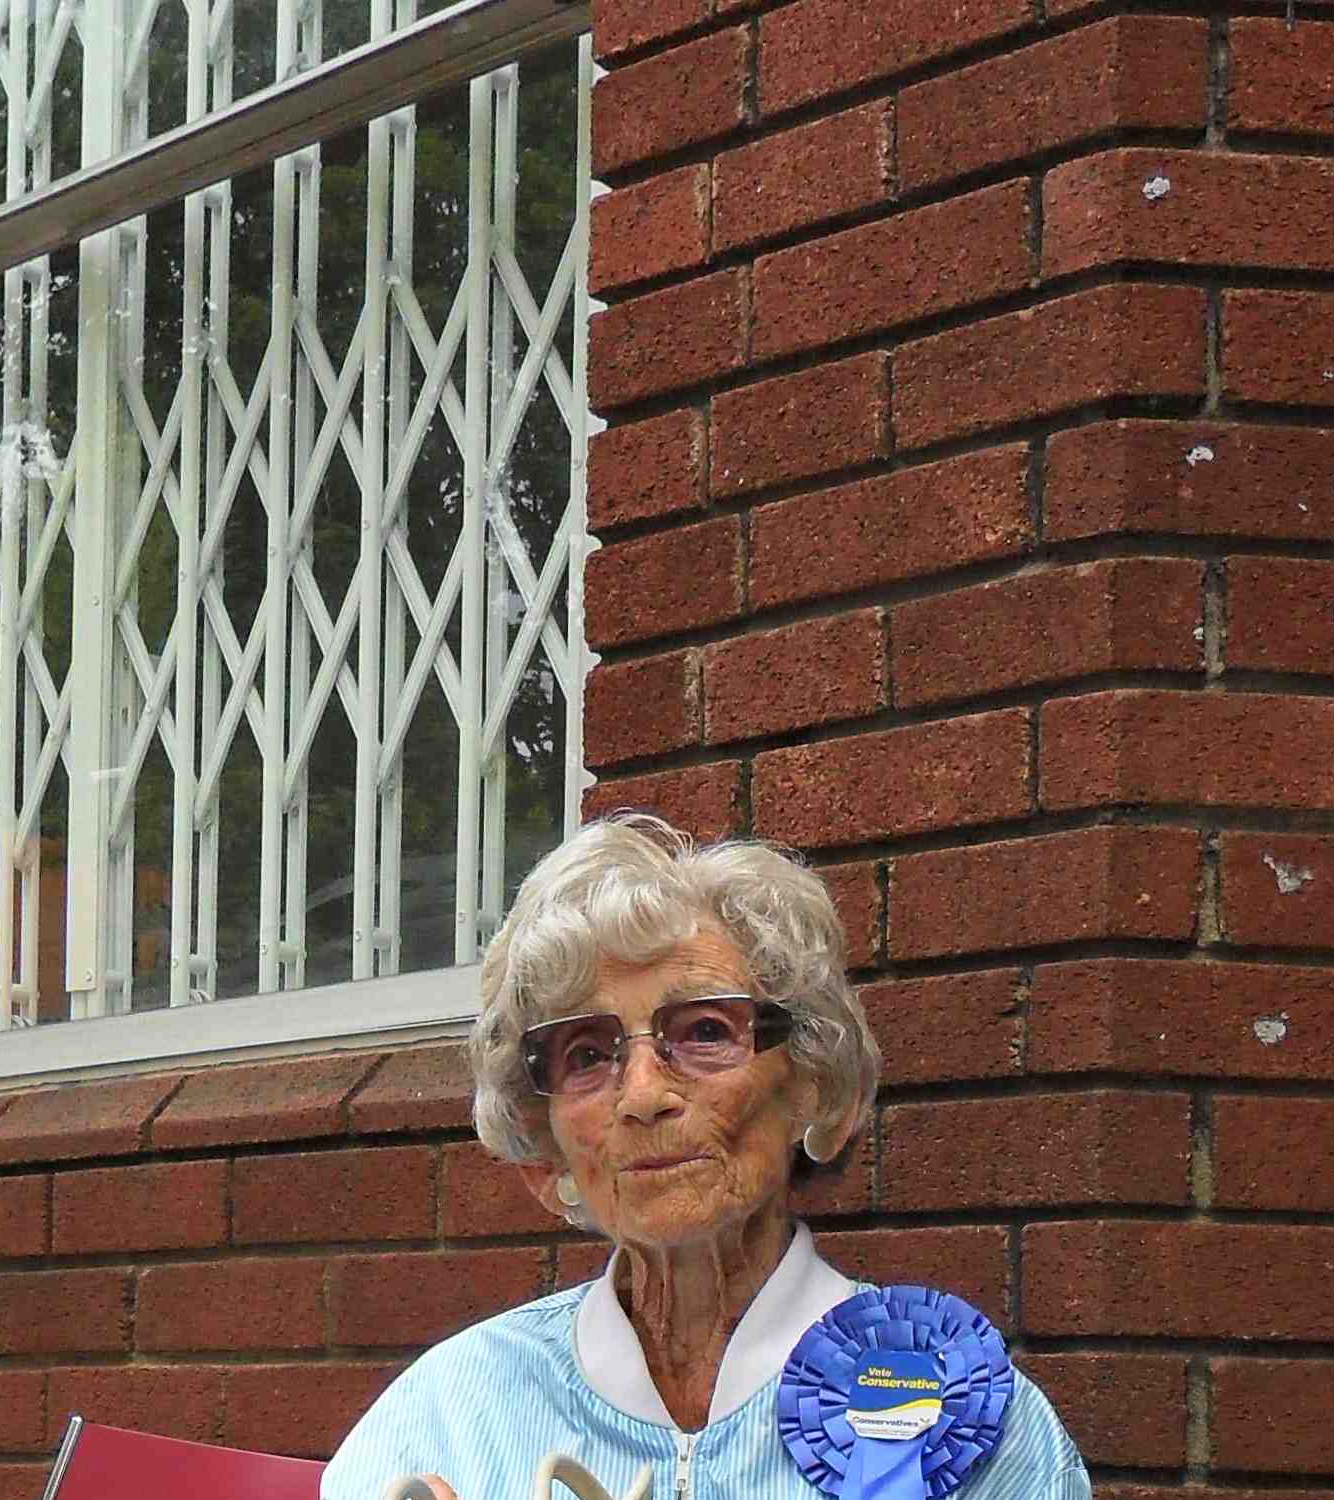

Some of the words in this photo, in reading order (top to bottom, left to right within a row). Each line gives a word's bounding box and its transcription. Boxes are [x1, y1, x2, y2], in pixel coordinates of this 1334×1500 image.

[868, 1367, 892, 1378] Vote
[857, 1375, 940, 1391] Conservative
[852, 1416, 919, 1427] Conservatives
